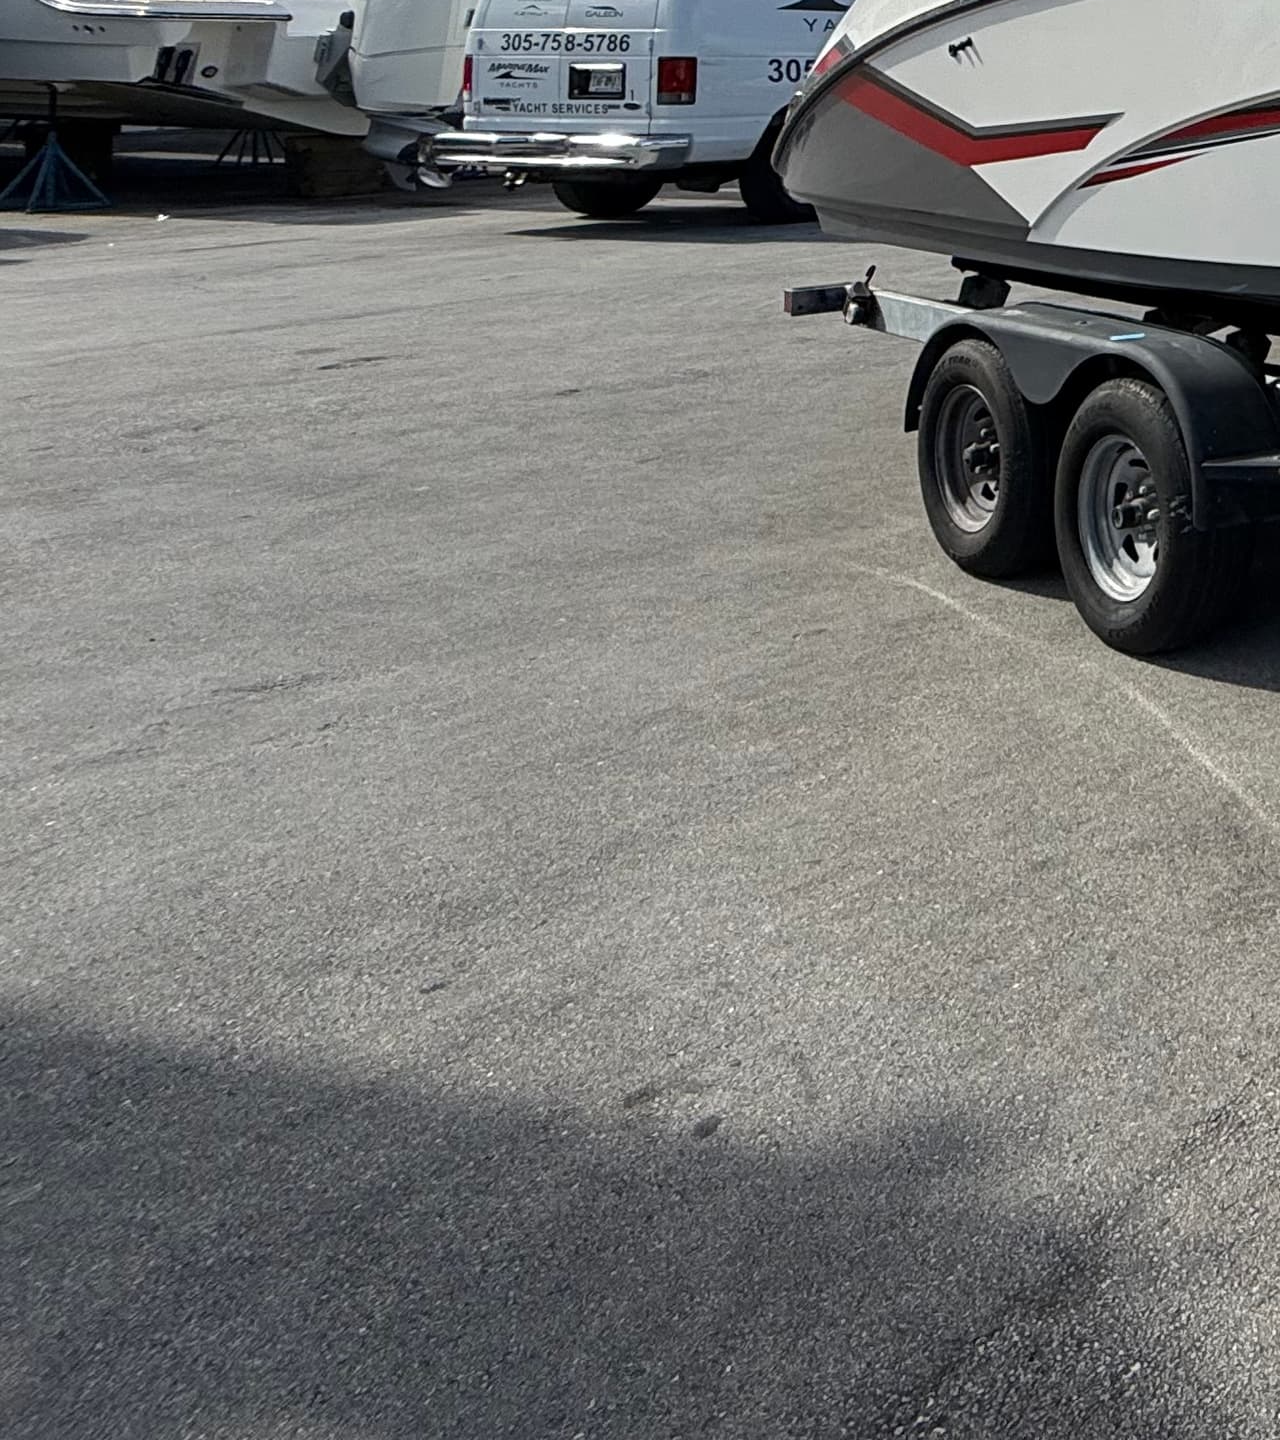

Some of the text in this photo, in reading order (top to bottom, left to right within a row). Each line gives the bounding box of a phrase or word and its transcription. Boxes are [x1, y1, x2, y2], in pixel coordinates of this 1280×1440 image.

[500, 33, 631, 52] 305-758-5786
[499, 81, 538, 89] YACHTS
[512, 102, 547, 113] YACHT
[551, 103, 609, 114] SERVICES
